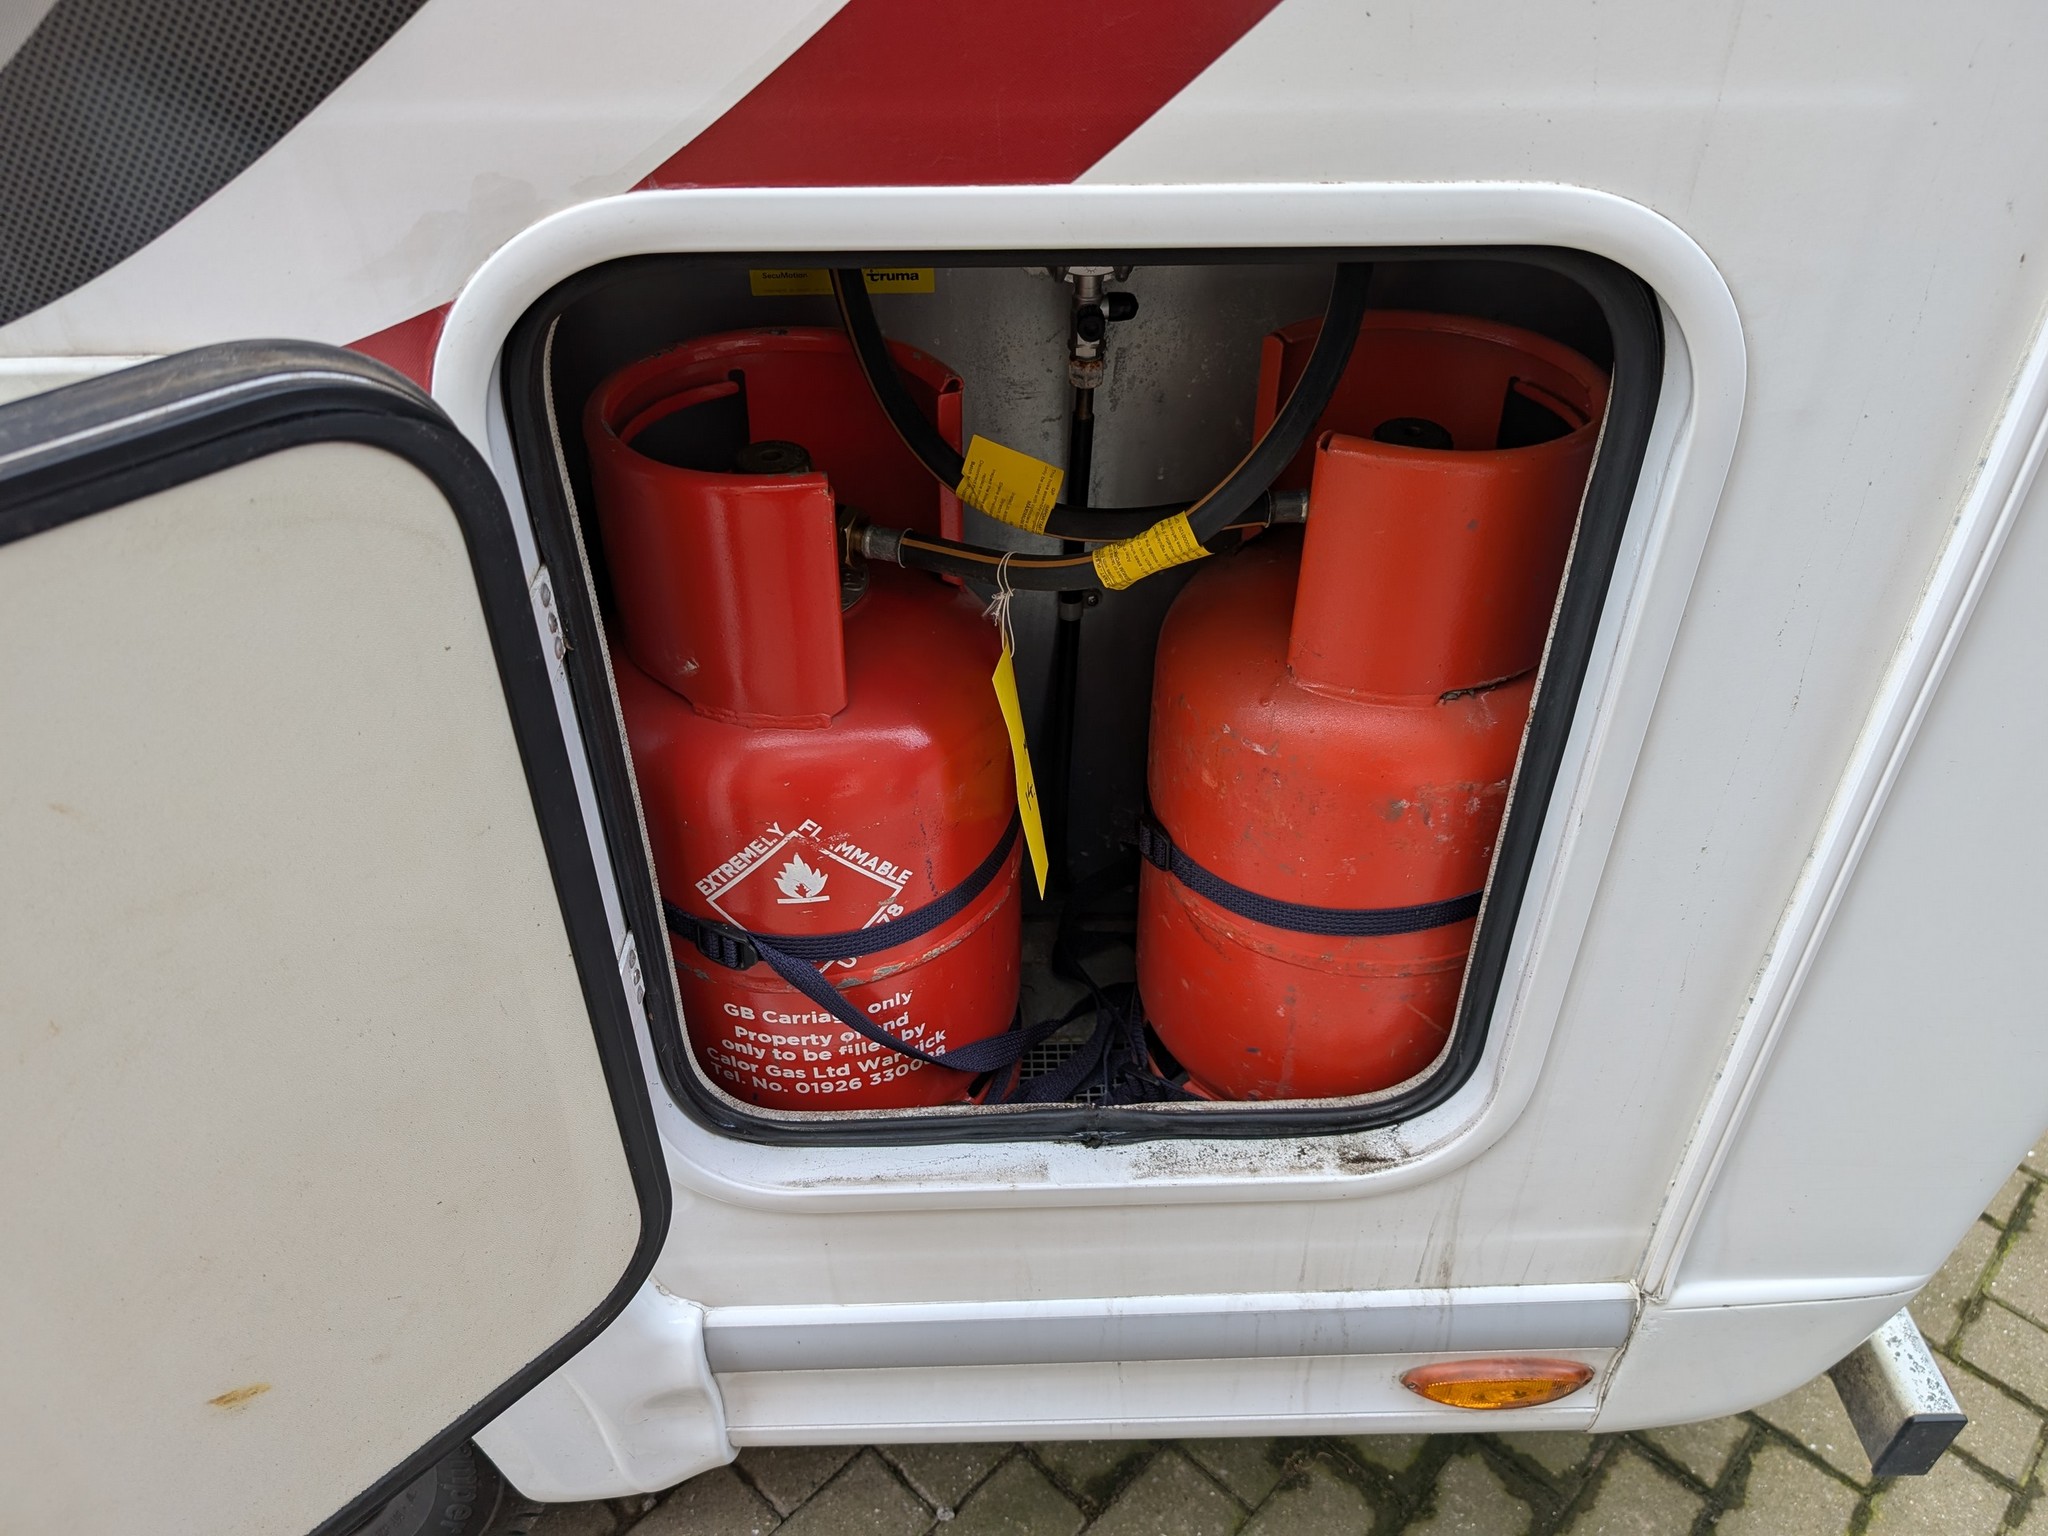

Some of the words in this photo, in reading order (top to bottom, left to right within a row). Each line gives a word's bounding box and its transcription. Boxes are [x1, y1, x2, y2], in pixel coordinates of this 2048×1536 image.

[761, 271, 808, 279] SecuMotion
[866, 269, 919, 281] truma
[694, 821, 785, 896] EXTREMELY
[799, 818, 914, 884] FLMMABLE
[723, 1002, 755, 1020] GB
[867, 989, 913, 1013] only
[721, 1038, 765, 1059] only
[772, 1048, 796, 1061] to
[802, 1048, 832, 1061] be
[838, 1036, 890, 1055] fille
[901, 1022, 925, 1041] by
[734, 1025, 832, 1047] Property
[877, 1011, 909, 1031] nd
[706, 1046, 759, 1073] Calor
[765, 1064, 806, 1078] Gas
[812, 1063, 850, 1079] Ltd
[710, 1061, 746, 1085] Tel.
[751, 1076, 788, 1093] No.
[794, 1077, 862, 1094] 01926
